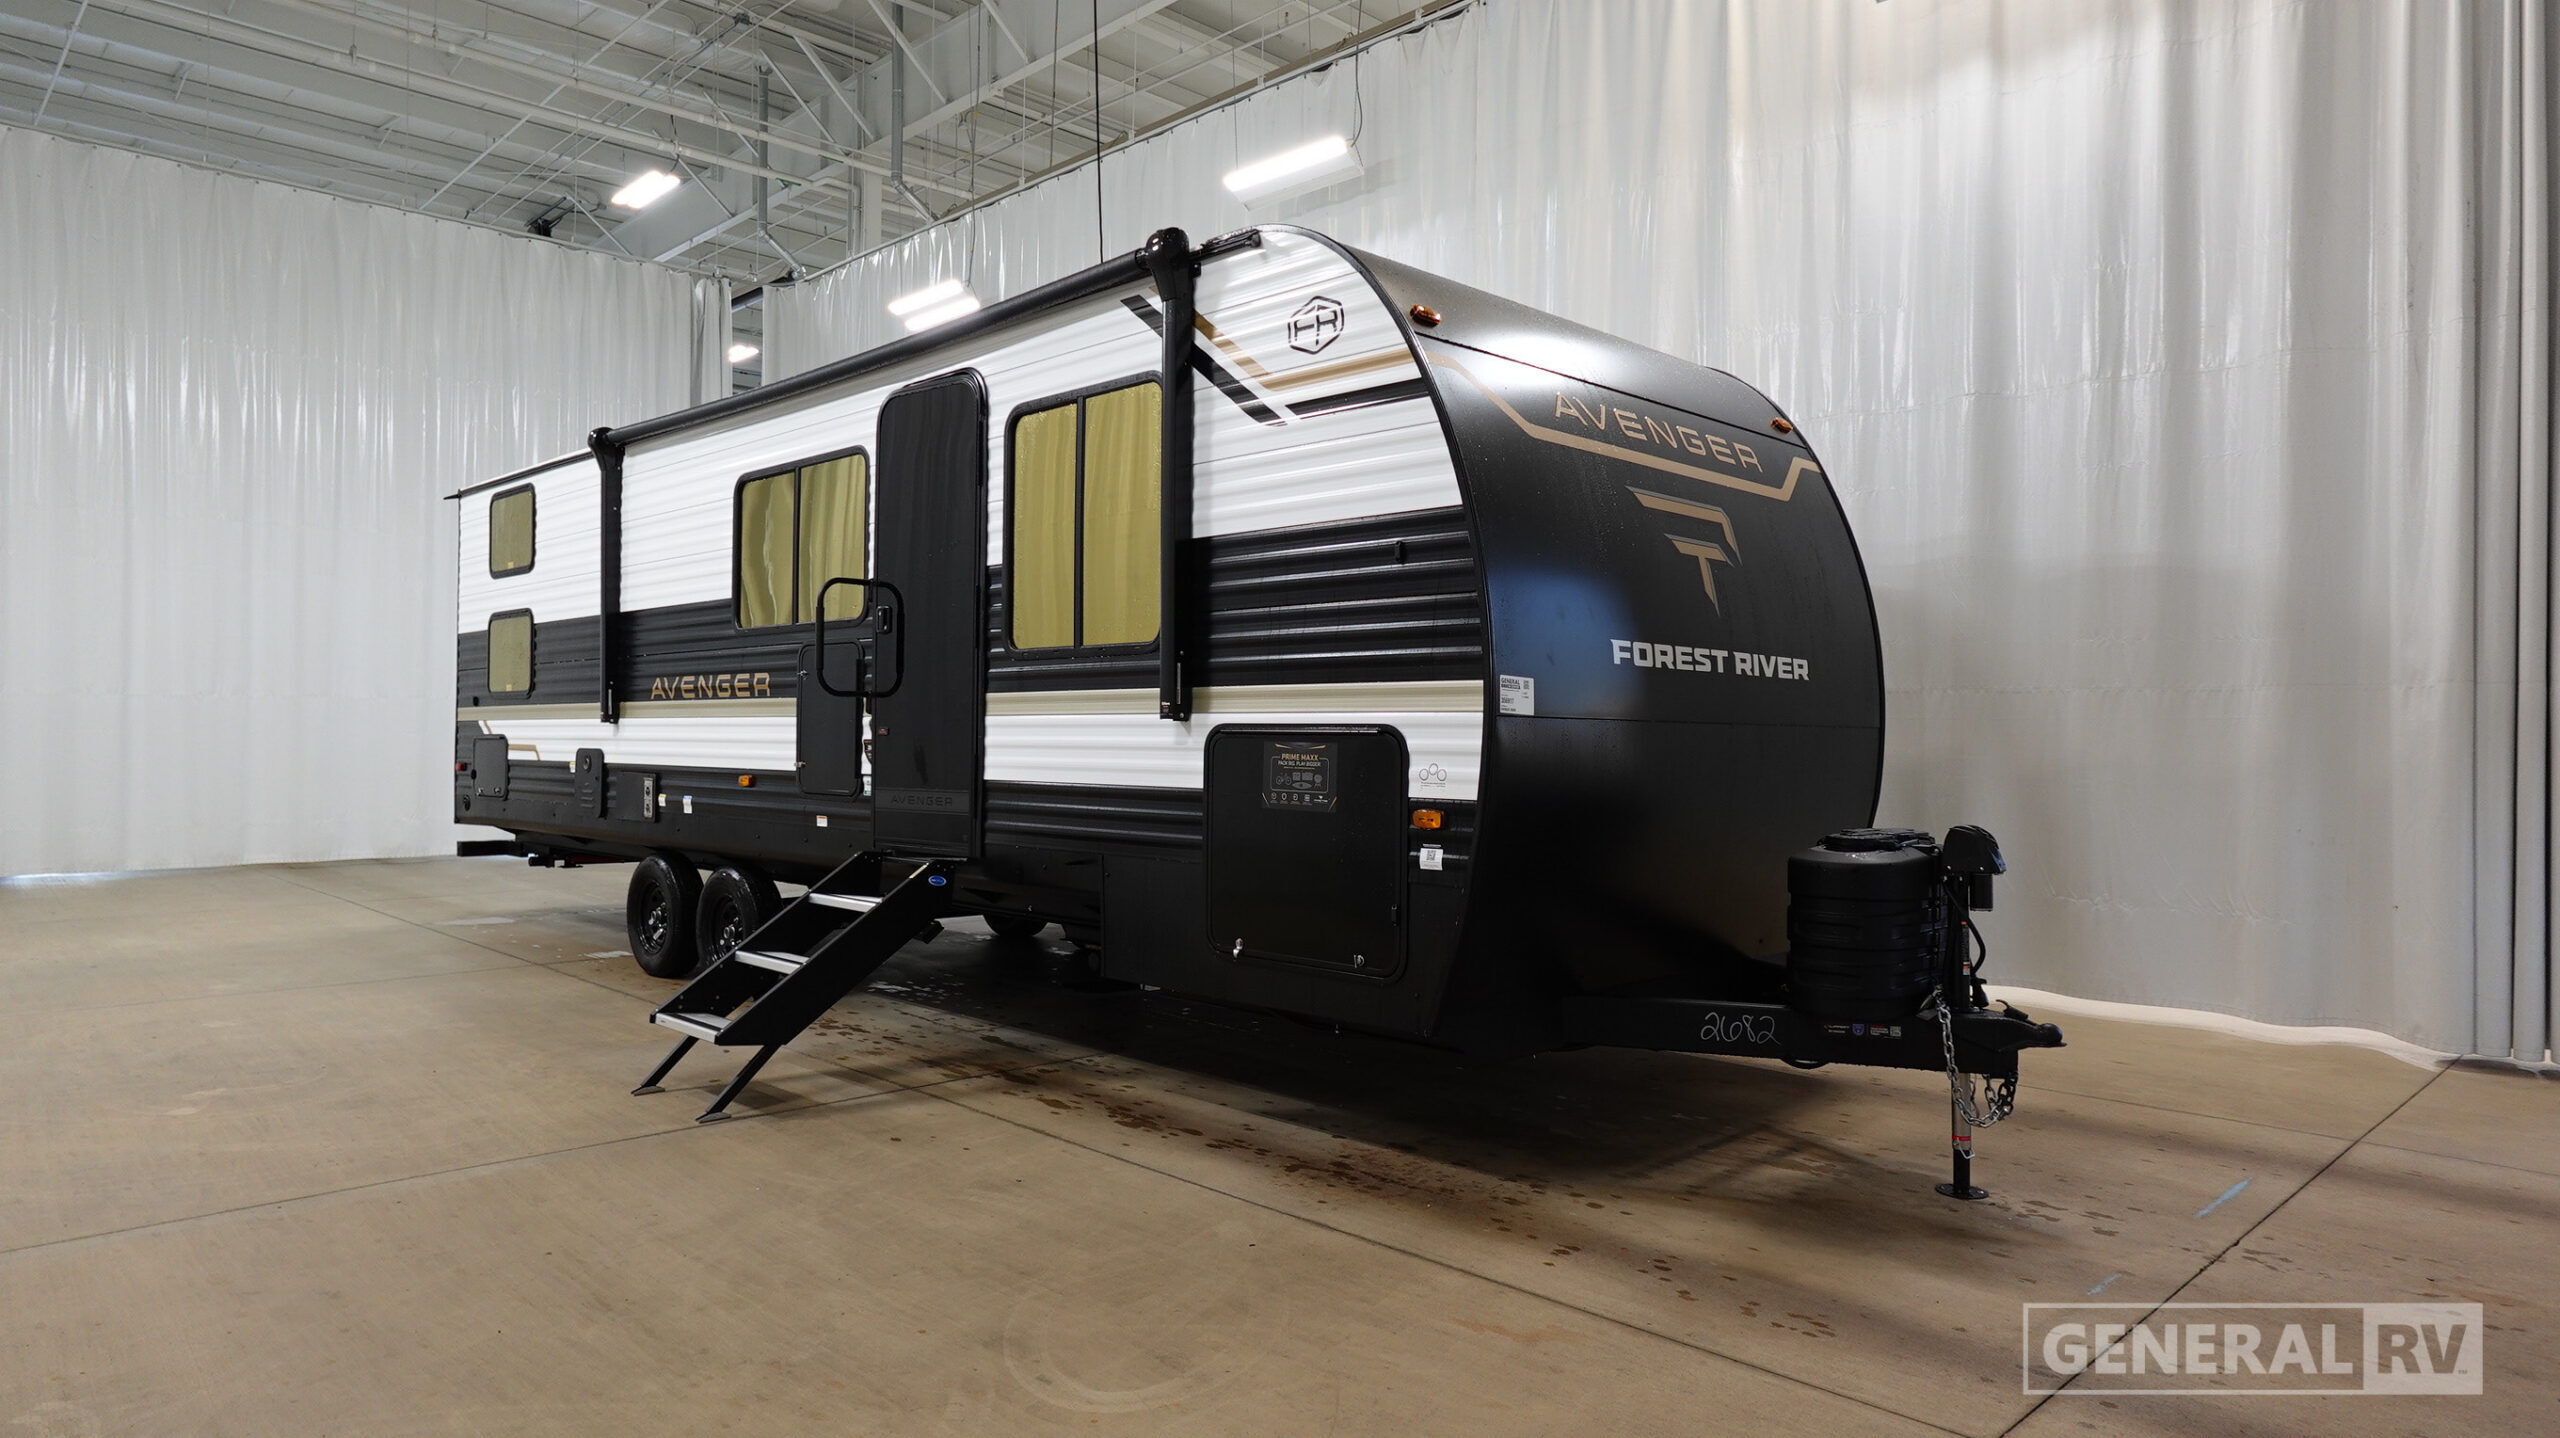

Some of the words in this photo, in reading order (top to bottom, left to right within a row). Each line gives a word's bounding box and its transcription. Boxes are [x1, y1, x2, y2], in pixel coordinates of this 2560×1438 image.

[1554, 391, 1763, 473] AVENGER
[1610, 638, 1729, 673] FOREST
[1732, 651, 1810, 681] RIVER
[650, 672, 770, 700] AVENGER
[1281, 753, 1300, 761] PRIME
[890, 793, 953, 808] AVENGER
[1700, 1011, 1782, 1045] 2682
